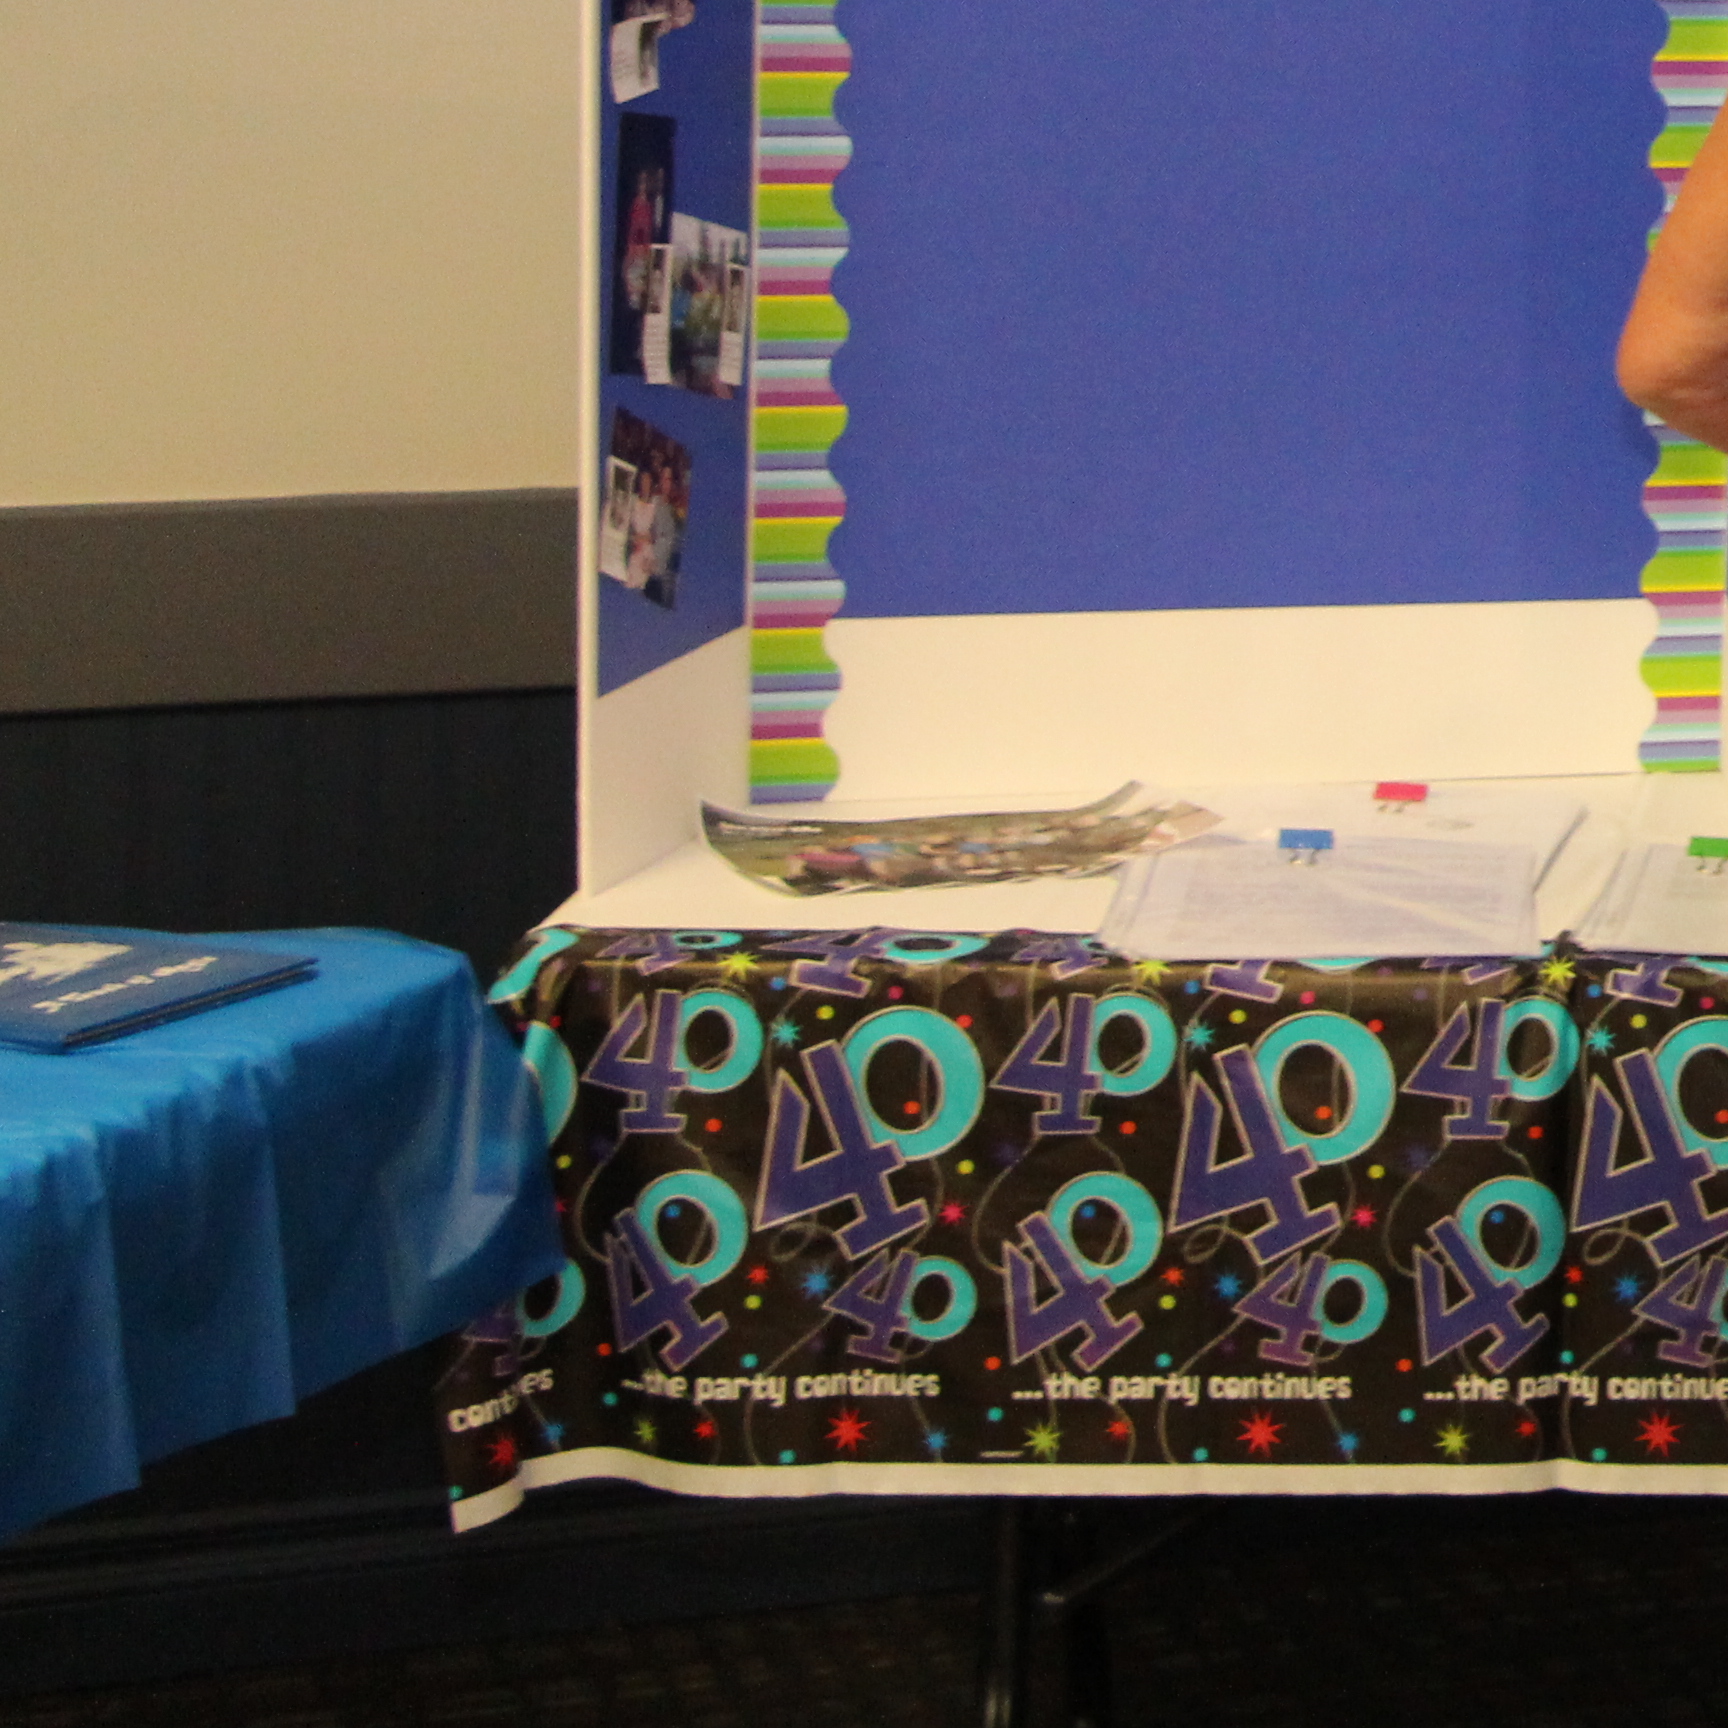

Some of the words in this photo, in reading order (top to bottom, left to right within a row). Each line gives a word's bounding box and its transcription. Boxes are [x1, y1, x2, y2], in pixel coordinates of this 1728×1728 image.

[581, 988, 765, 1134] 40
[753, 1005, 986, 1261] 40
[990, 992, 1177, 1138] 40
[1402, 996, 1581, 1141] 40
[1167, 1010, 1396, 1266] 40
[605, 1169, 748, 1373] 40
[824, 1247, 977, 1364] 40
[1002, 1171, 1163, 1373] 40
[1234, 1250, 1389, 1368] 40
[1413, 1175, 1567, 1374] 40
[694, 1373, 787, 1408] party
[794, 1368, 941, 1400] continues
[1110, 1372, 1200, 1407] party
[1207, 1373, 1352, 1400] continues
[1517, 1373, 1599, 1407] party
